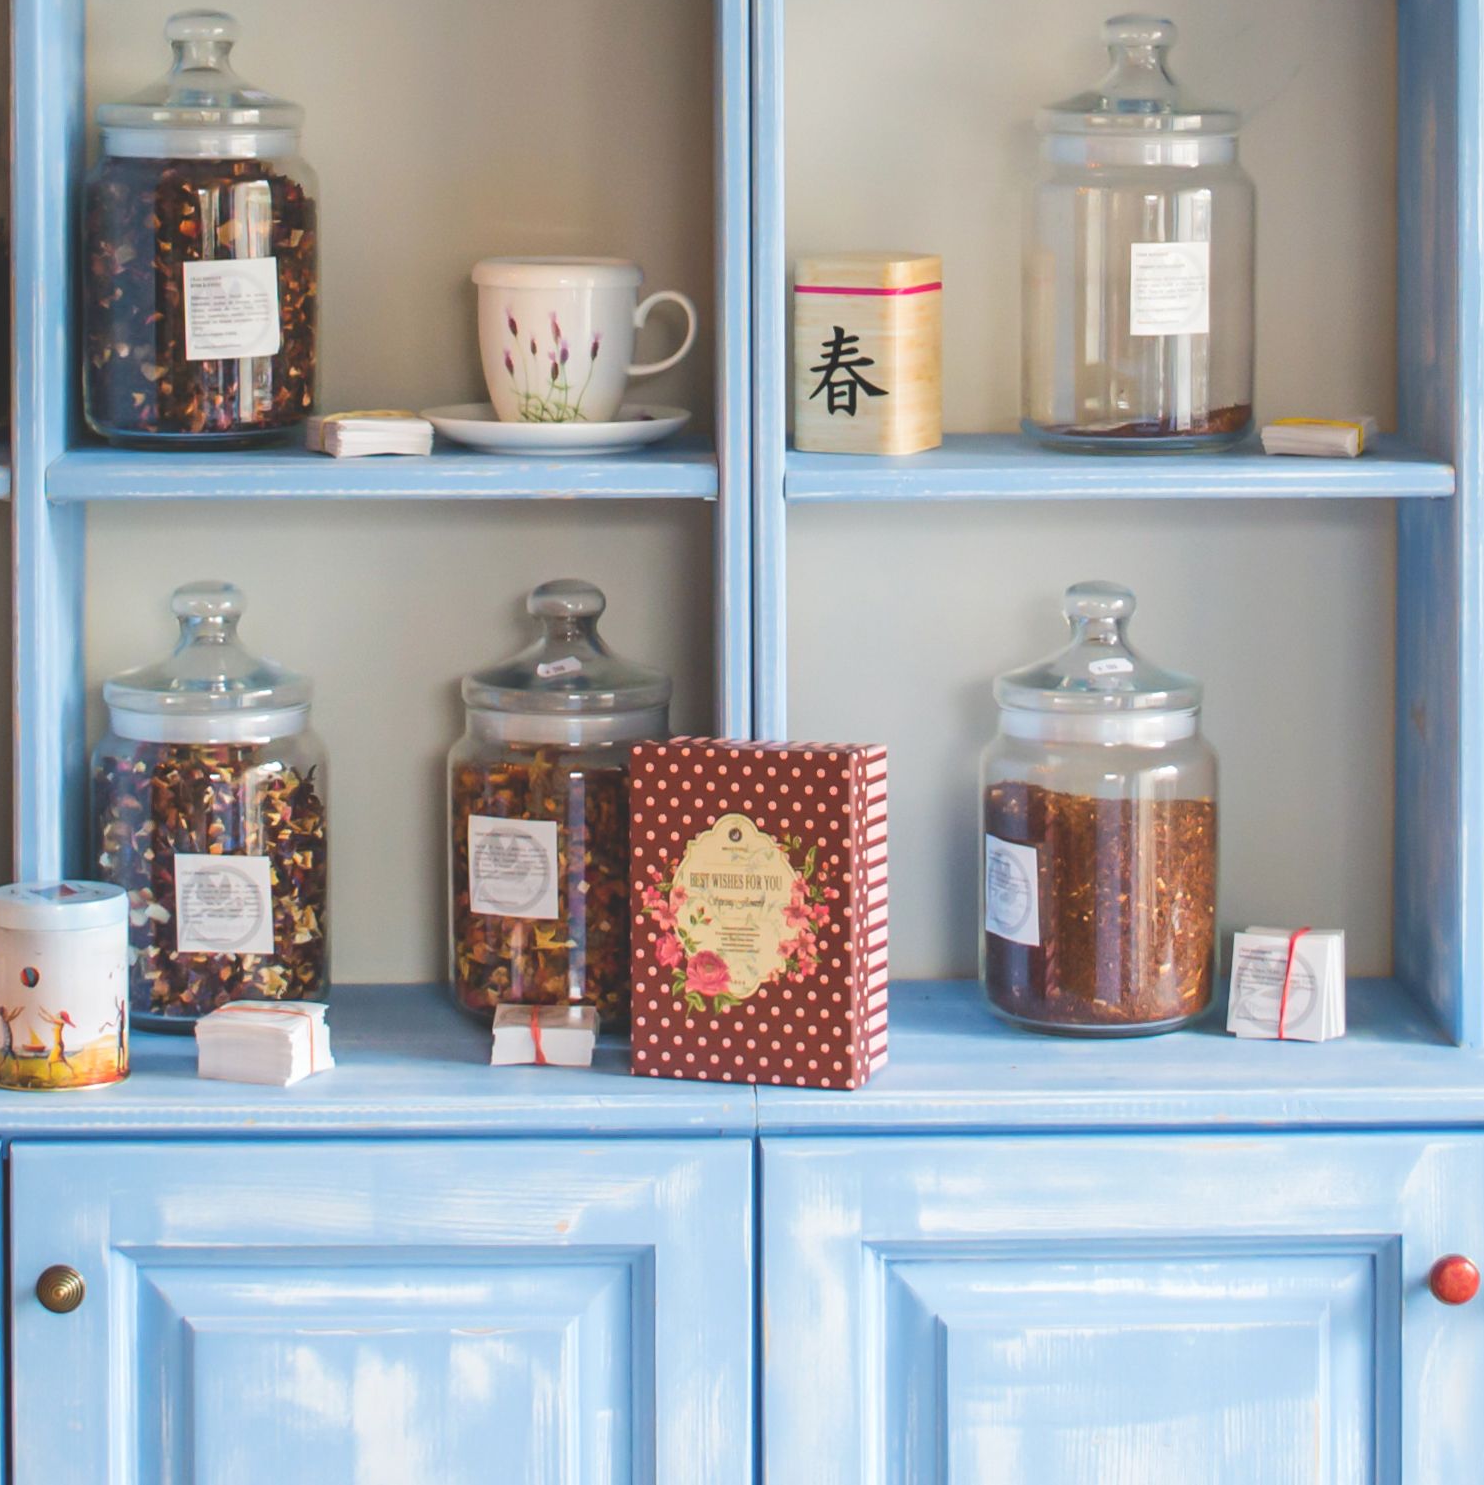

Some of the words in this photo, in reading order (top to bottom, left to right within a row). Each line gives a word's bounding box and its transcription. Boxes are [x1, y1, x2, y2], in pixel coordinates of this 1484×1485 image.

[808, 325, 890, 418] 春
[690, 872, 710, 889] BEST
[711, 873, 745, 890] WISHES
[746, 874, 763, 890] FOR
[764, 874, 783, 892] YOU
